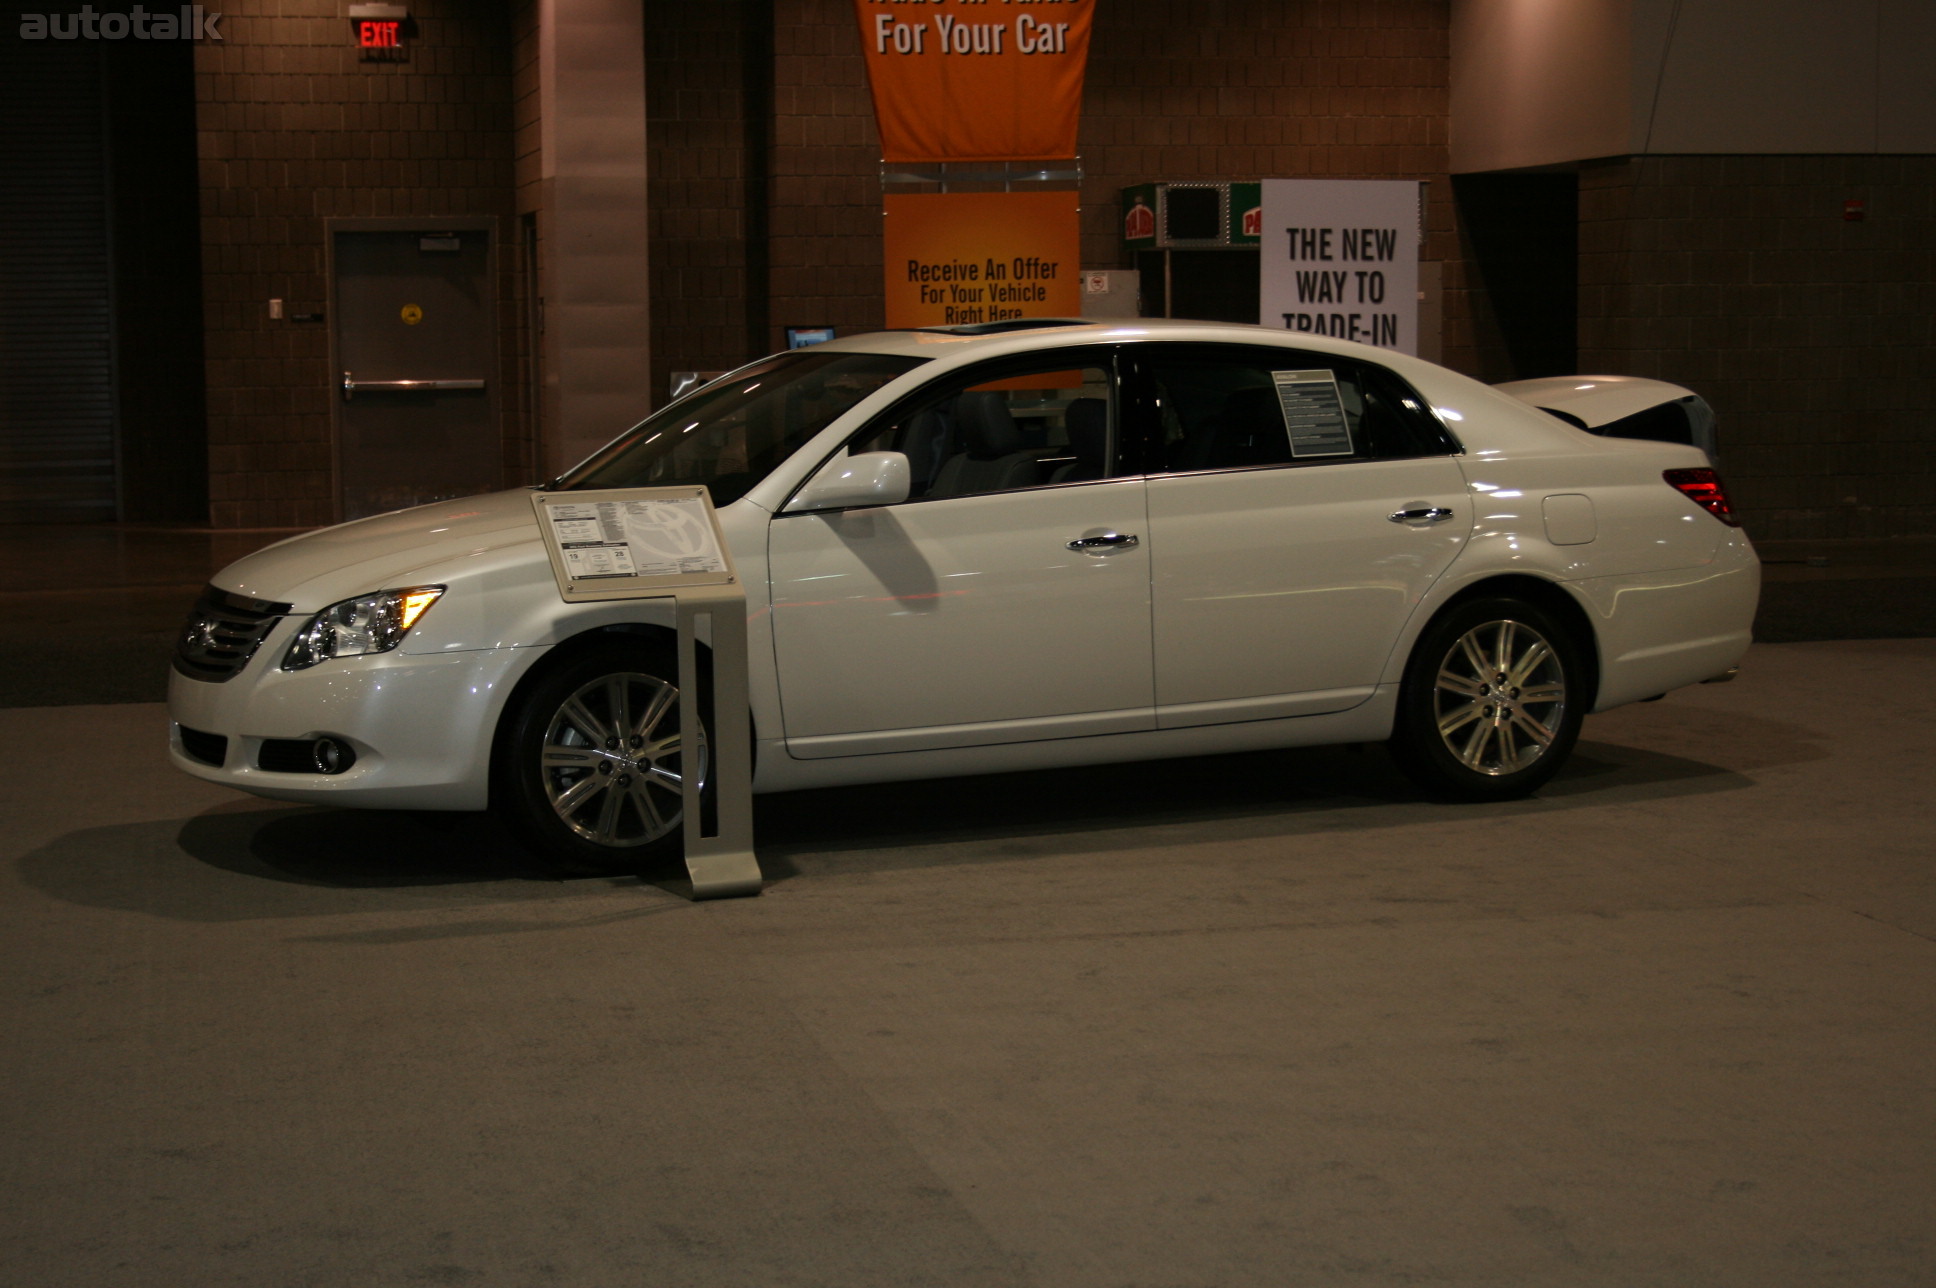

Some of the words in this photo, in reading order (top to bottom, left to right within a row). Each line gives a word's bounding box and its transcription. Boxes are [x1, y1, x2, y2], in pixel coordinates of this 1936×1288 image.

[361, 22, 398, 47] EXIT
[875, 14, 927, 54] For
[934, 14, 1005, 54] Your
[1015, 14, 1069, 54] Car
[1286, 228, 1333, 261] THE
[1342, 228, 1397, 261] NEW
[908, 259, 979, 282] Receive
[985, 258, 1006, 280] An
[1013, 257, 1058, 280] Offer
[921, 284, 945, 304] For
[950, 284, 984, 304] Your
[989, 282, 1046, 302] Vehicle
[1296, 271, 1347, 304] WAY
[1355, 271, 1384, 304] TO
[945, 306, 984, 325] Right
[989, 305, 1022, 322] Here
[1282, 313, 1397, 346] TRADE-IN
